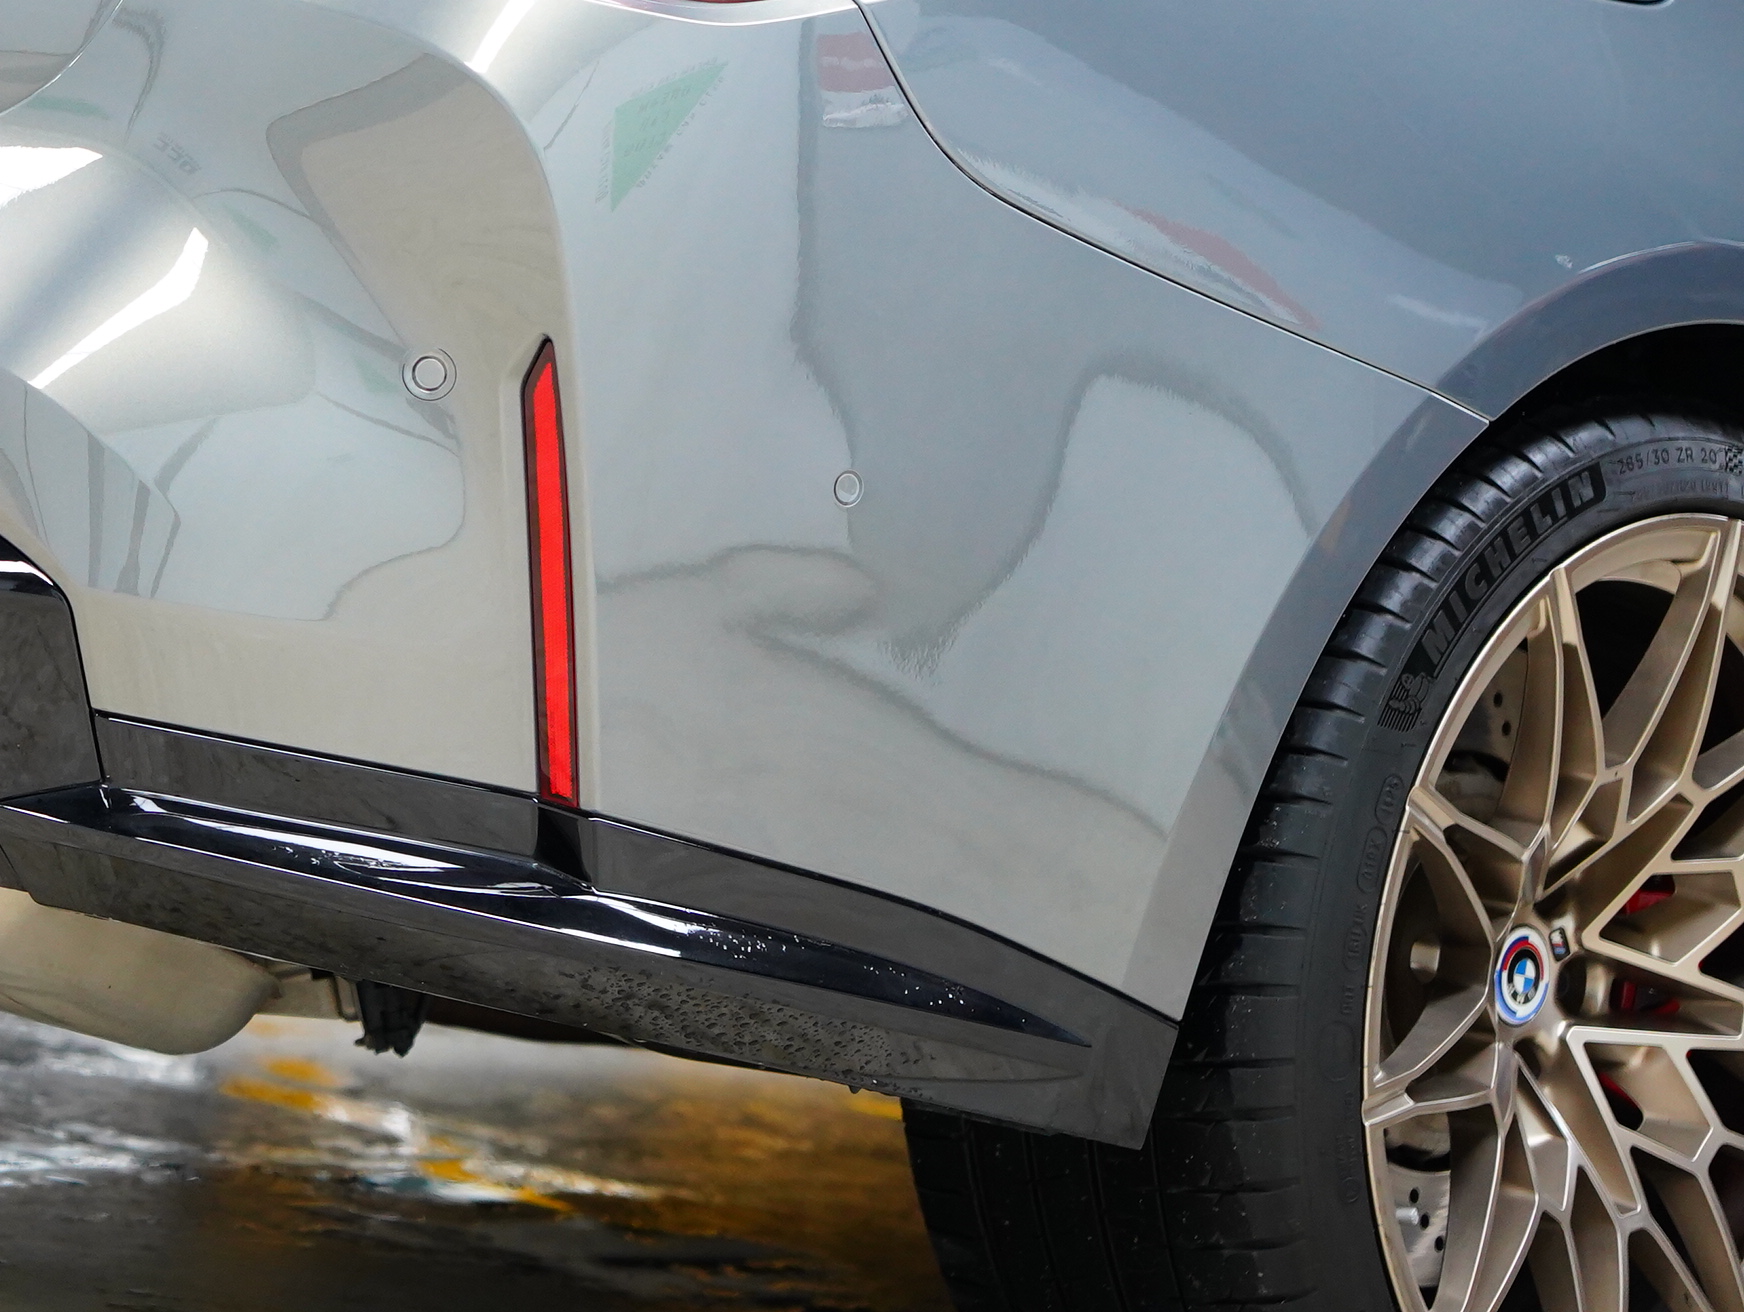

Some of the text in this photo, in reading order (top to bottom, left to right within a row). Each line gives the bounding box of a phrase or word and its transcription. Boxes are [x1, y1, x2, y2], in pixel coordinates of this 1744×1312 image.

[1676, 447, 1694, 464] ZR
[1701, 448, 1717, 464] 20
[1420, 469, 1596, 664] MICHELIN
